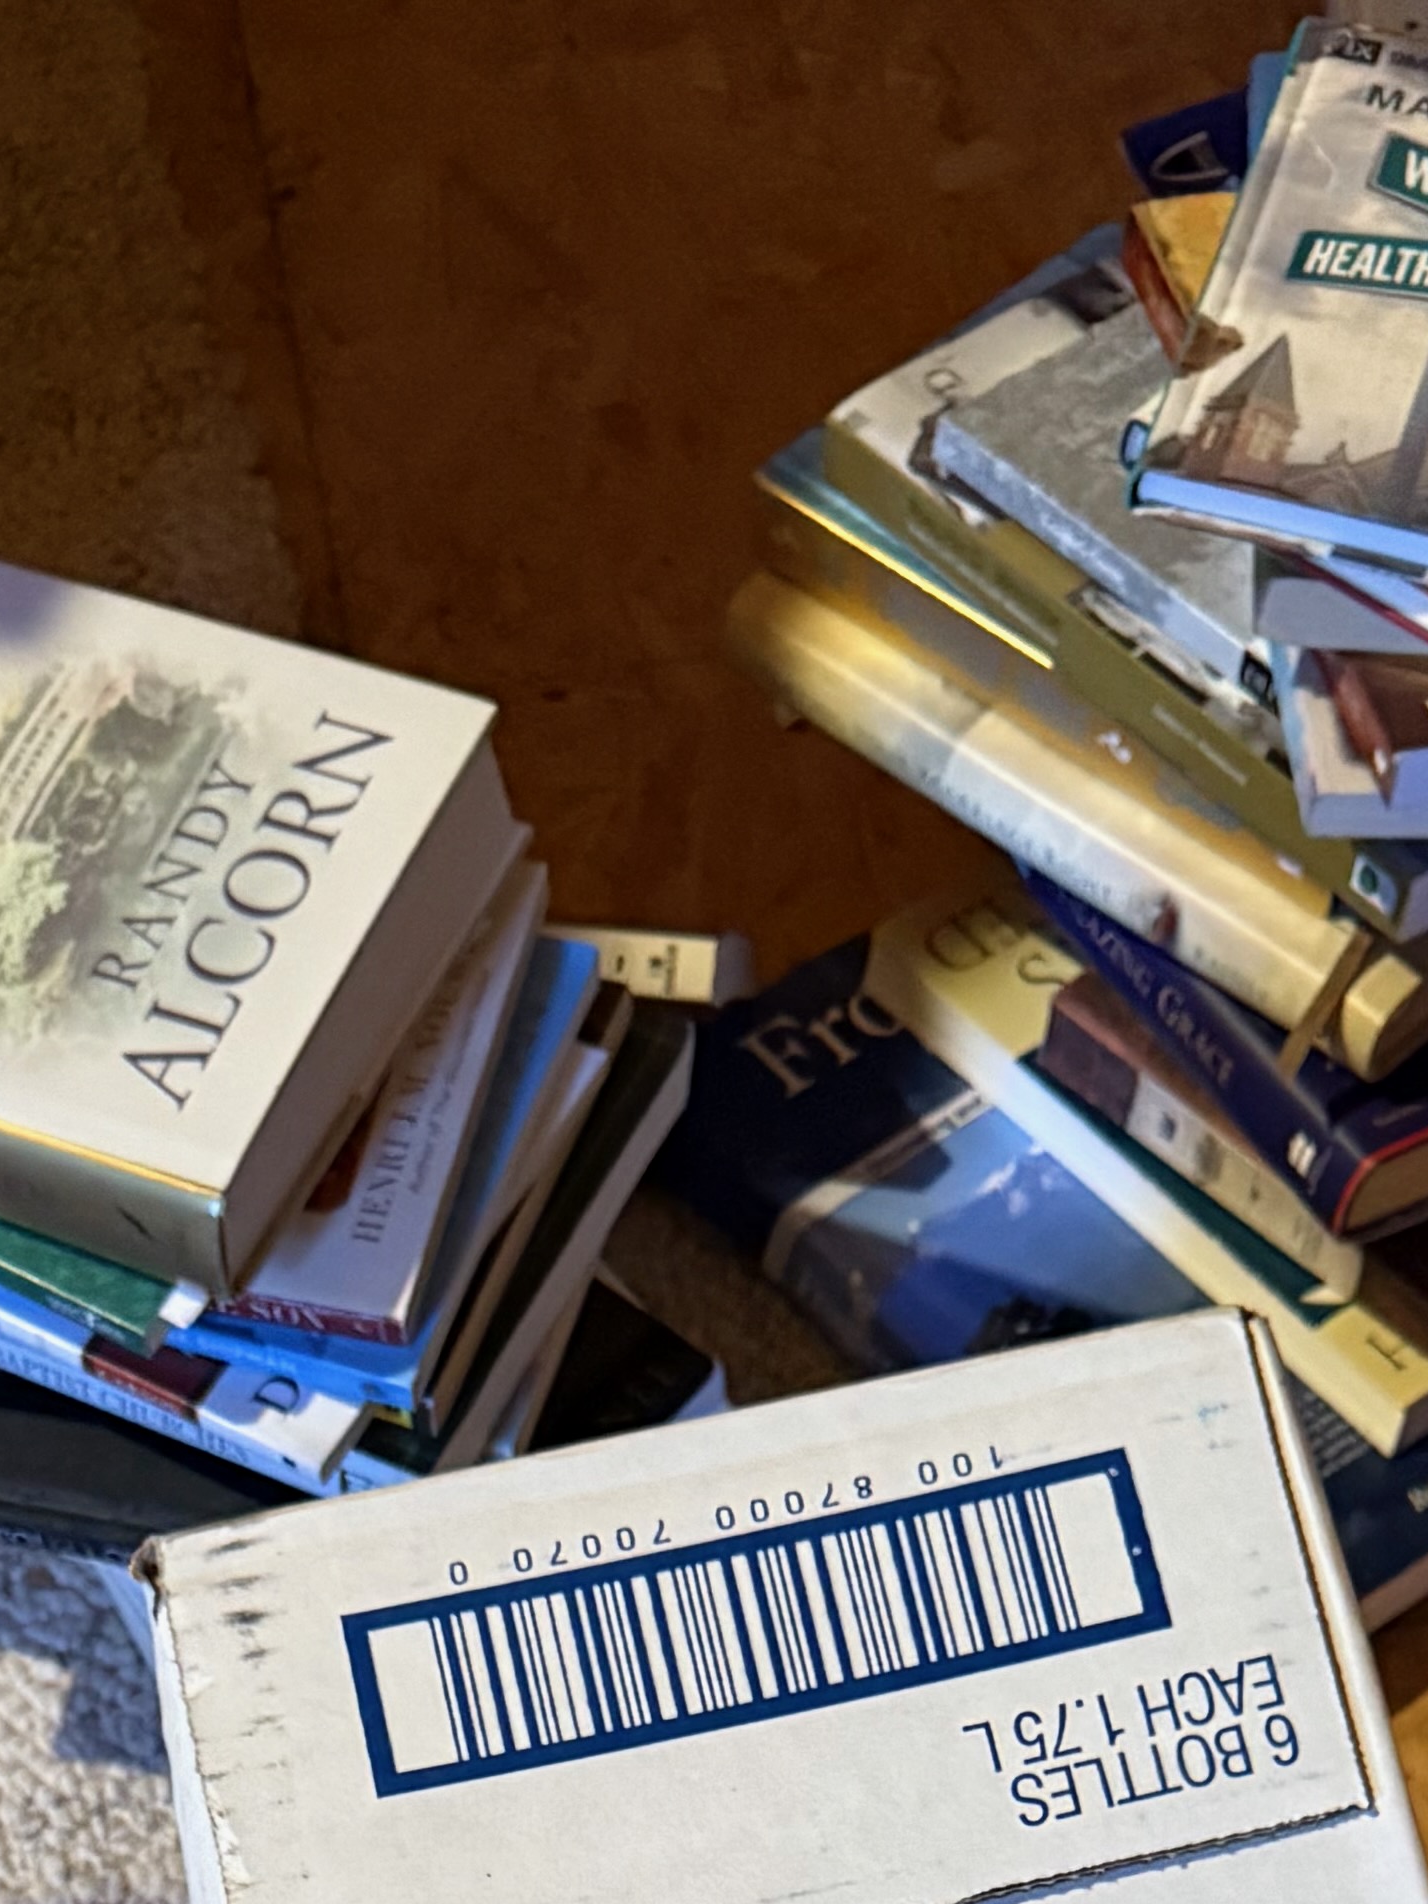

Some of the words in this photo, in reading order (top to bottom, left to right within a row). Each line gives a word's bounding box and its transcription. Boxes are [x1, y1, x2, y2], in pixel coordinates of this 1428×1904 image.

[88, 752, 261, 995] RANDY
[117, 706, 398, 1112] ALCORN
[351, 1141, 413, 1243] HENRI
[919, 1441, 1007, 1489] 100
[713, 1472, 877, 1537] 87000
[512, 1512, 677, 1577] 70070
[1014, 1682, 1132, 1756] 1.75
[1141, 1652, 1284, 1729] EACH
[962, 1720, 1005, 1774] L
[1263, 1710, 1302, 1767] 6
[1010, 1731, 1256, 1830] BOTTLES
